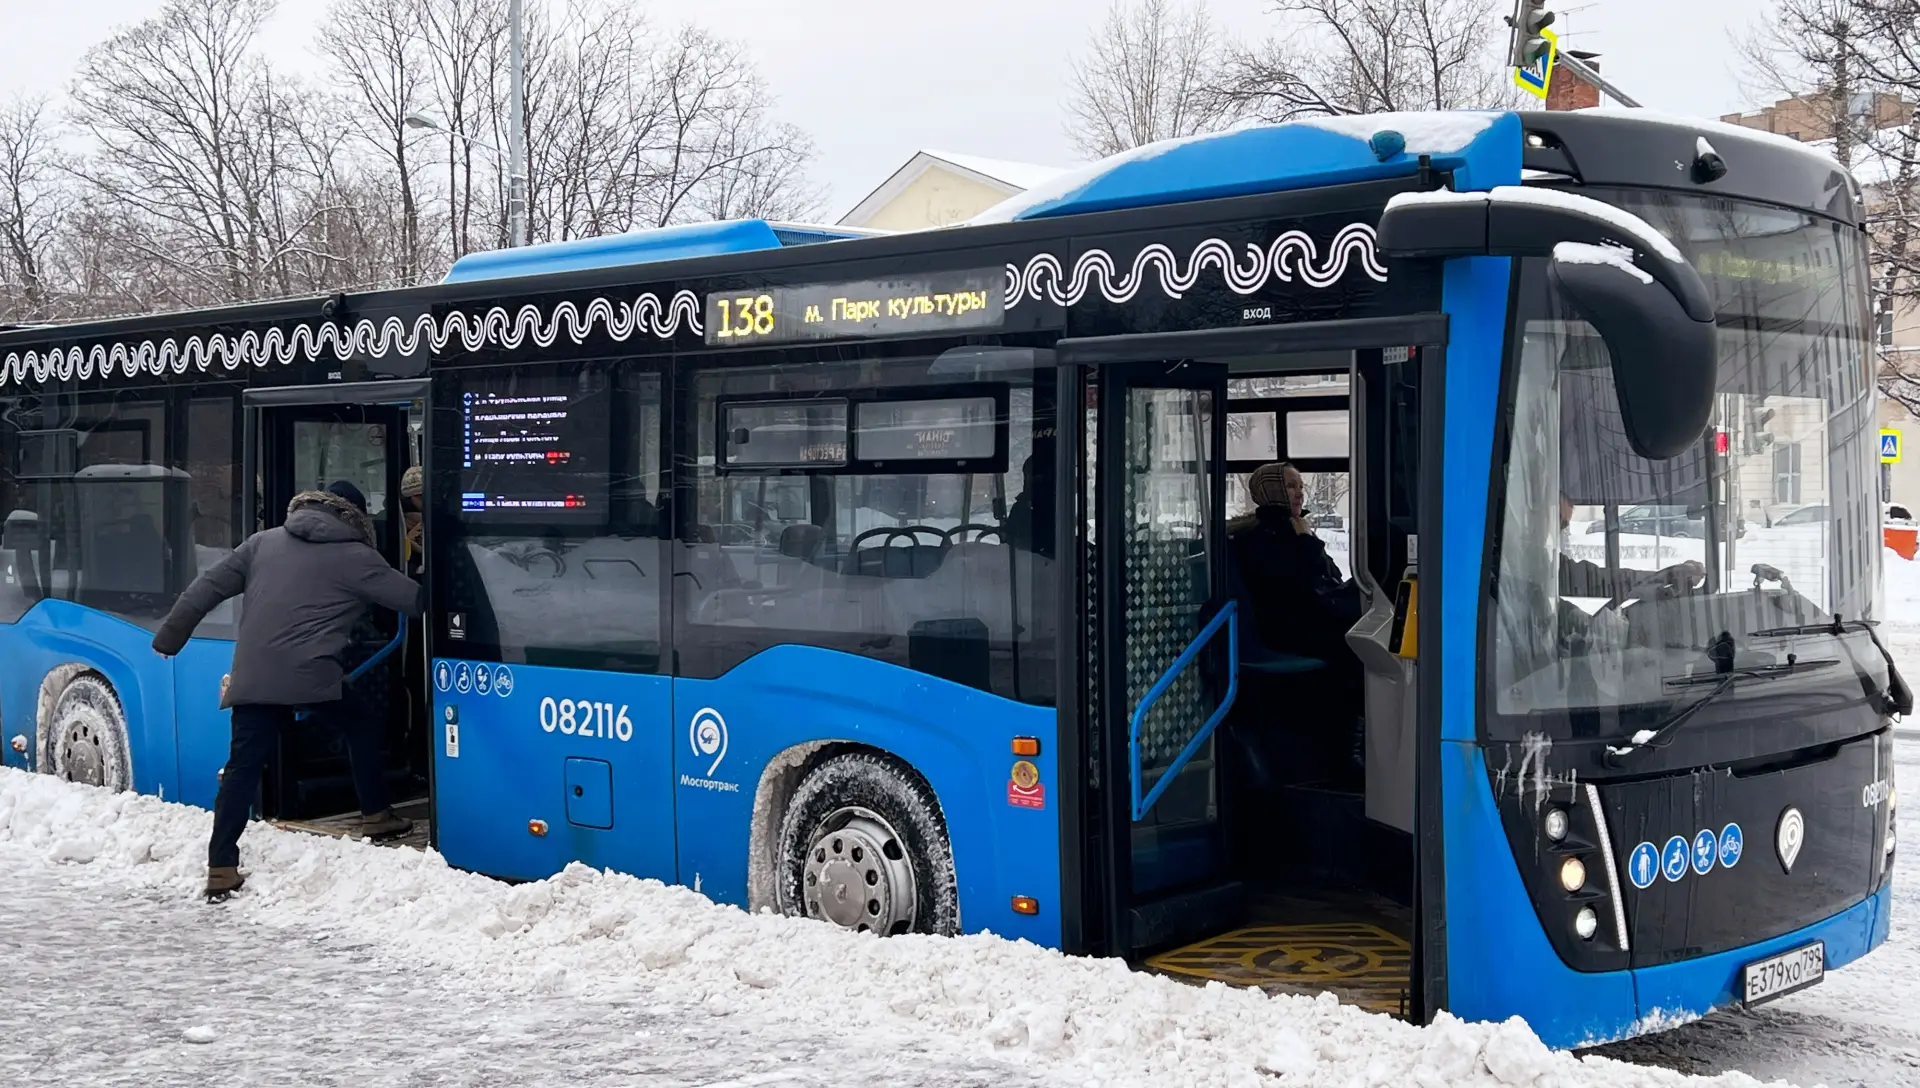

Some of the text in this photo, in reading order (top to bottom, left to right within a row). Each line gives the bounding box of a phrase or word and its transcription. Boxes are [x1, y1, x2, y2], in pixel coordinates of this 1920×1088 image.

[717, 290, 987, 338] 138 м. Парк культуры
[1243, 307, 1271, 320] ВХОД
[540, 696, 633, 742] 082116
[680, 774, 740, 793] Мосгортранс
